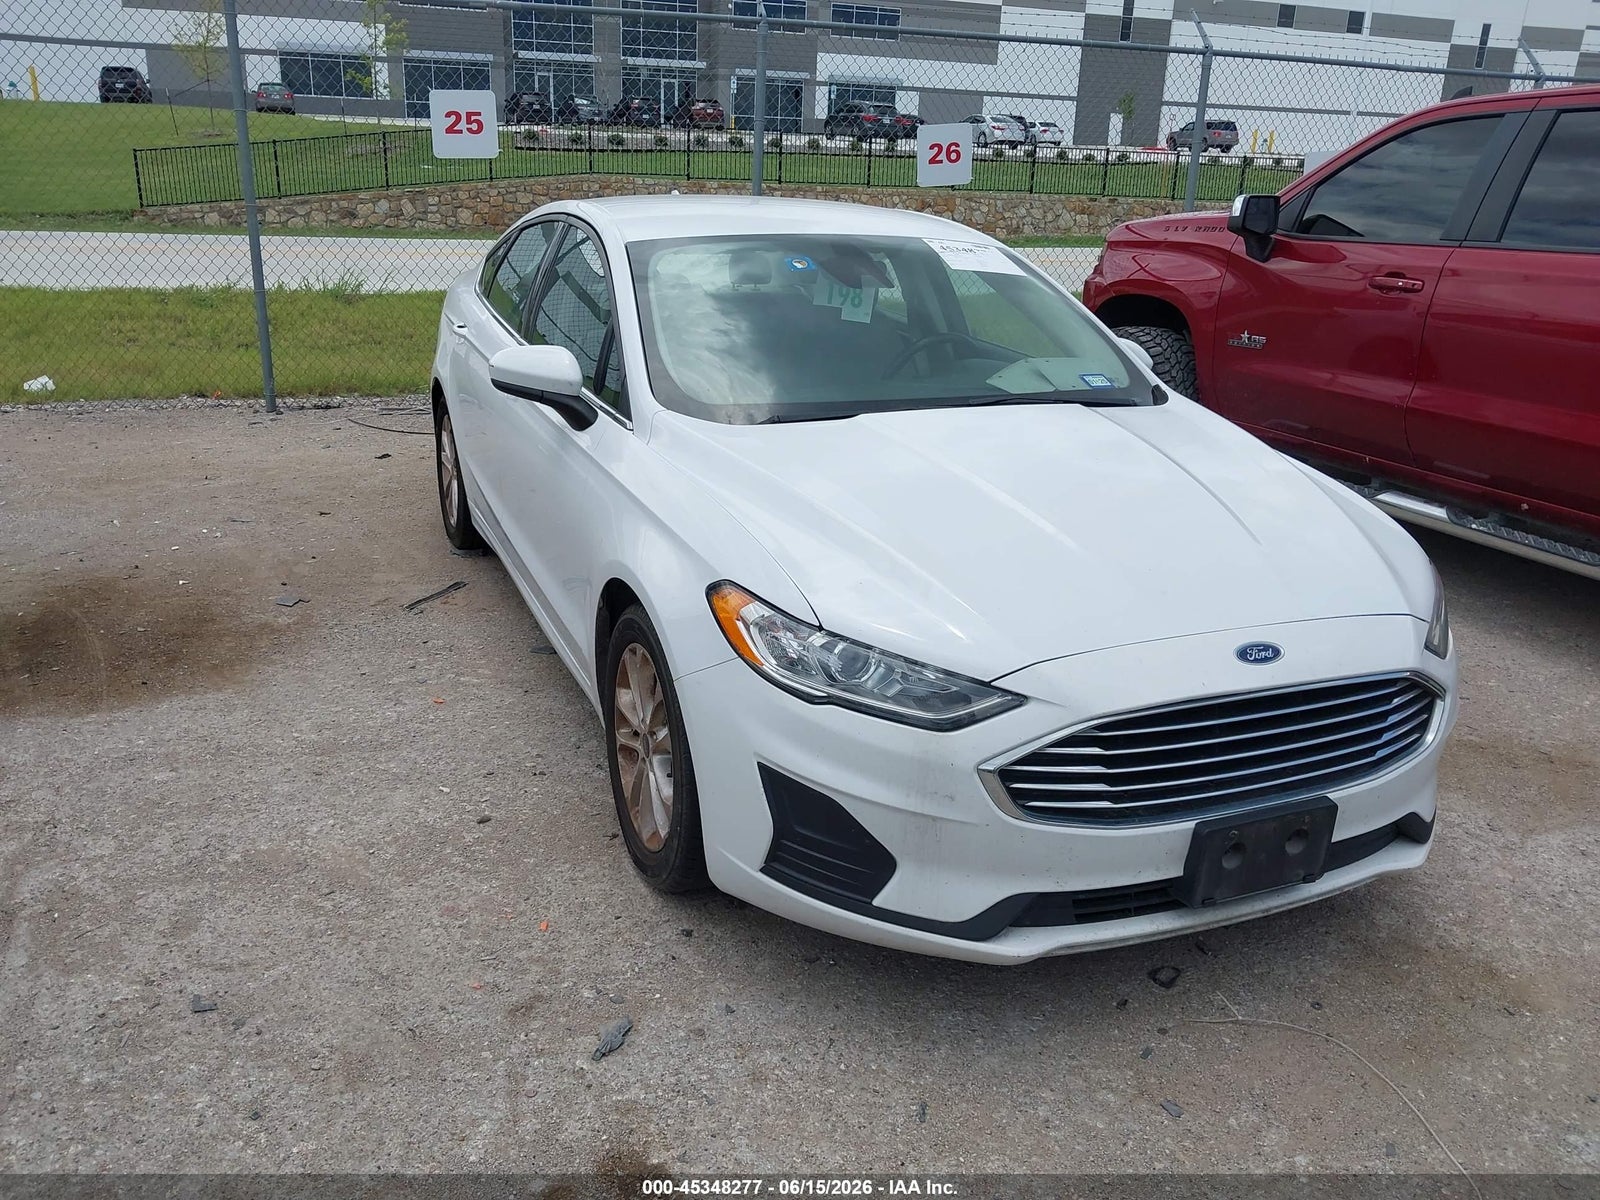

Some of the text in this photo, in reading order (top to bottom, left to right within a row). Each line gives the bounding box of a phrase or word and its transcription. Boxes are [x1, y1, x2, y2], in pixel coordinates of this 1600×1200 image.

[444, 110, 484, 135] 25
[928, 142, 962, 165] 26
[826, 281, 863, 309] 198
[1246, 646, 1275, 661] Ford
